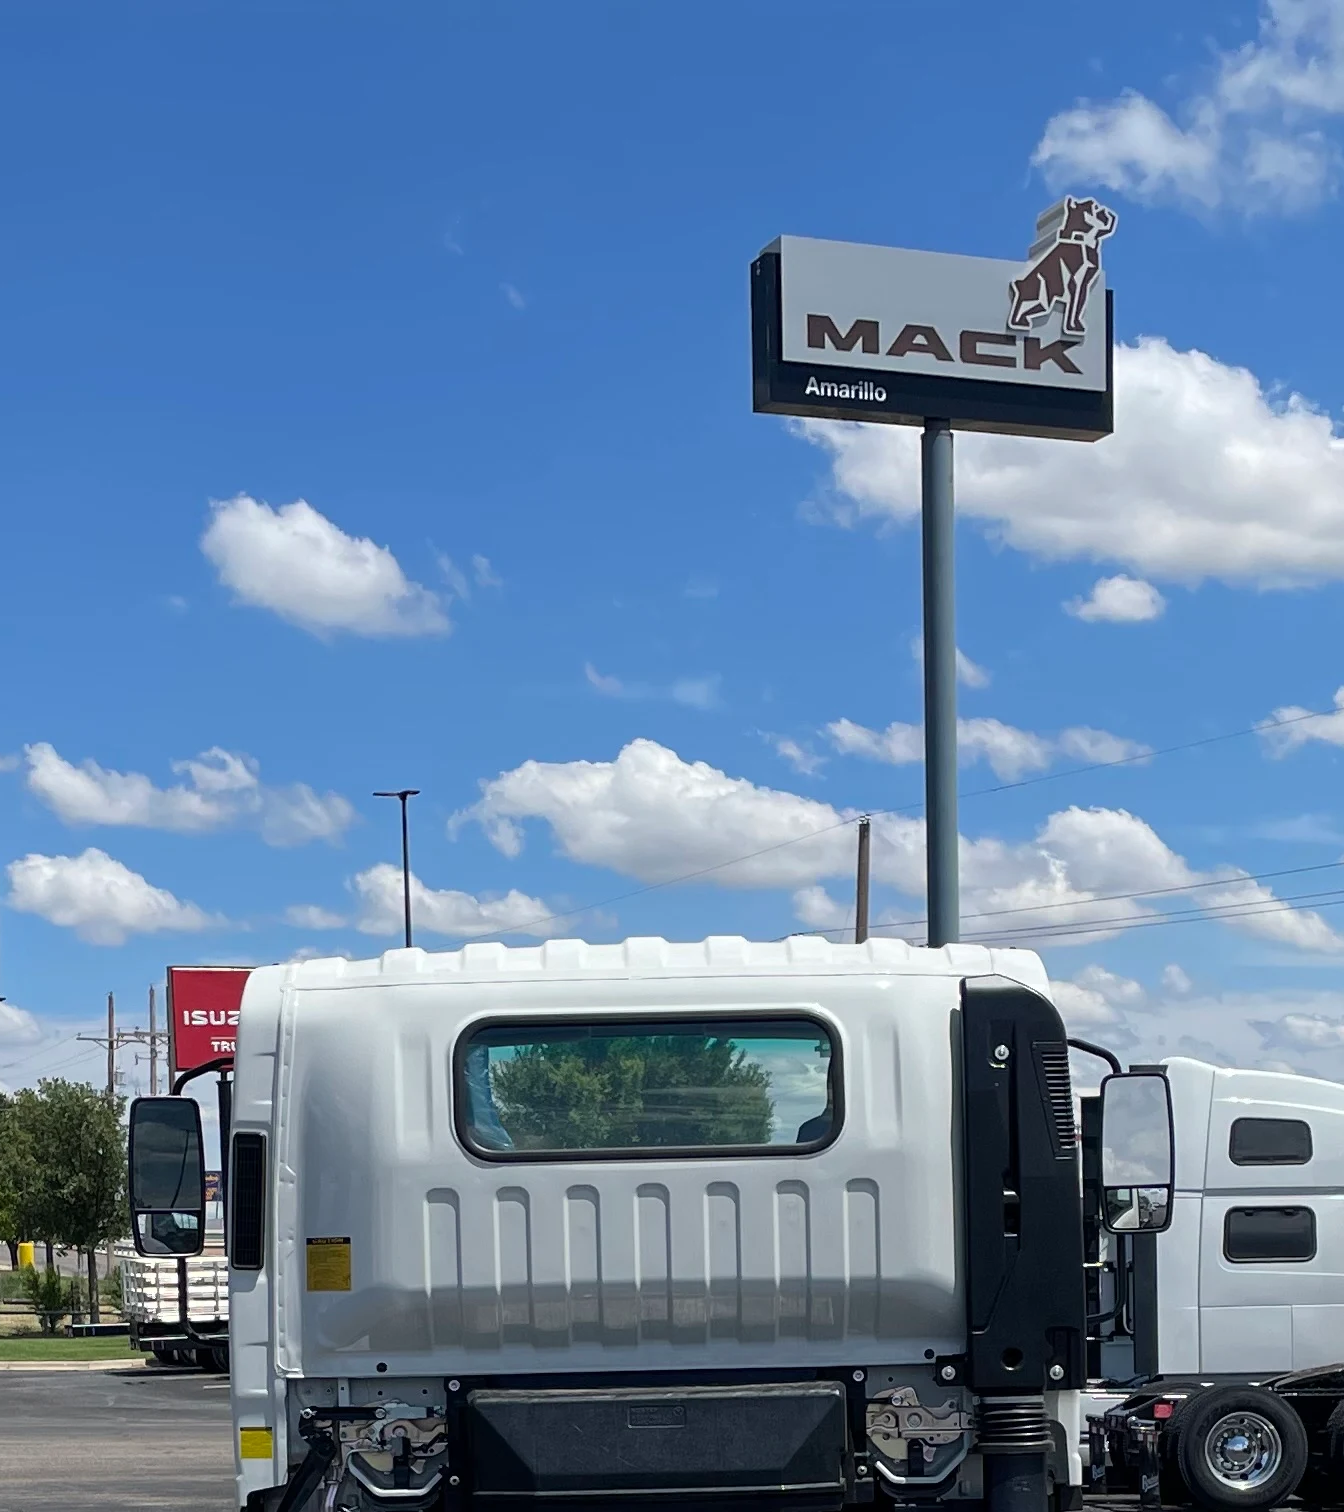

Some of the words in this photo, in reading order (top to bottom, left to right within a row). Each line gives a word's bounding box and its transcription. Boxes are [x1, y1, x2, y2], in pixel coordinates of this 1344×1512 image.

[806, 313, 1084, 375] MACK
[804, 376, 888, 402] Amarillo
[183, 1010, 240, 1026] ISUZ
